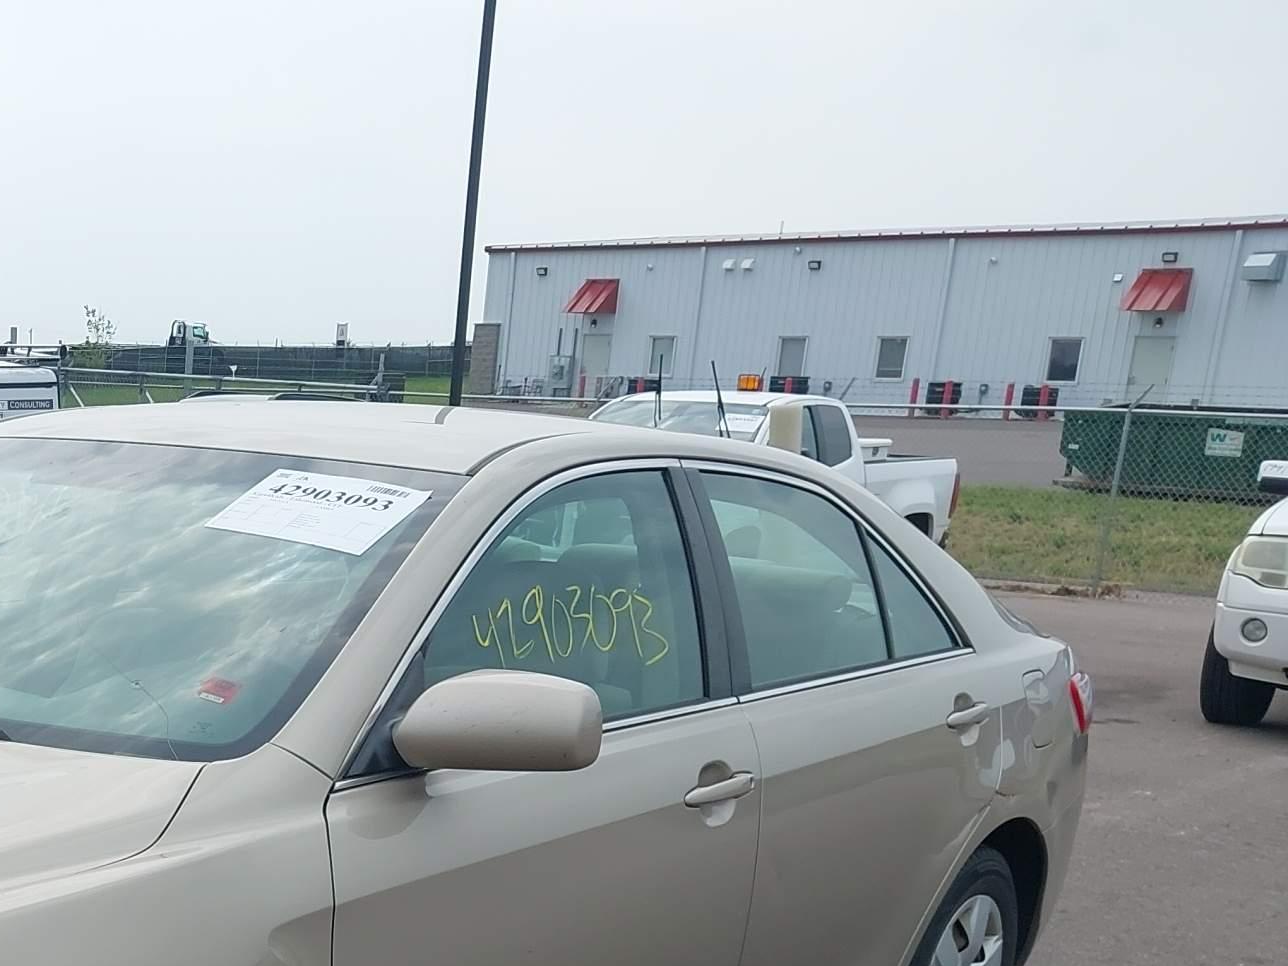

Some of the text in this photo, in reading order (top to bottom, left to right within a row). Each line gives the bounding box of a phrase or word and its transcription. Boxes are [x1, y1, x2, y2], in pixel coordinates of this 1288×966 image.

[9, 399, 51, 409] CONSULTING
[269, 483, 395, 512] 42903093
[472, 584, 669, 668] 42903093
